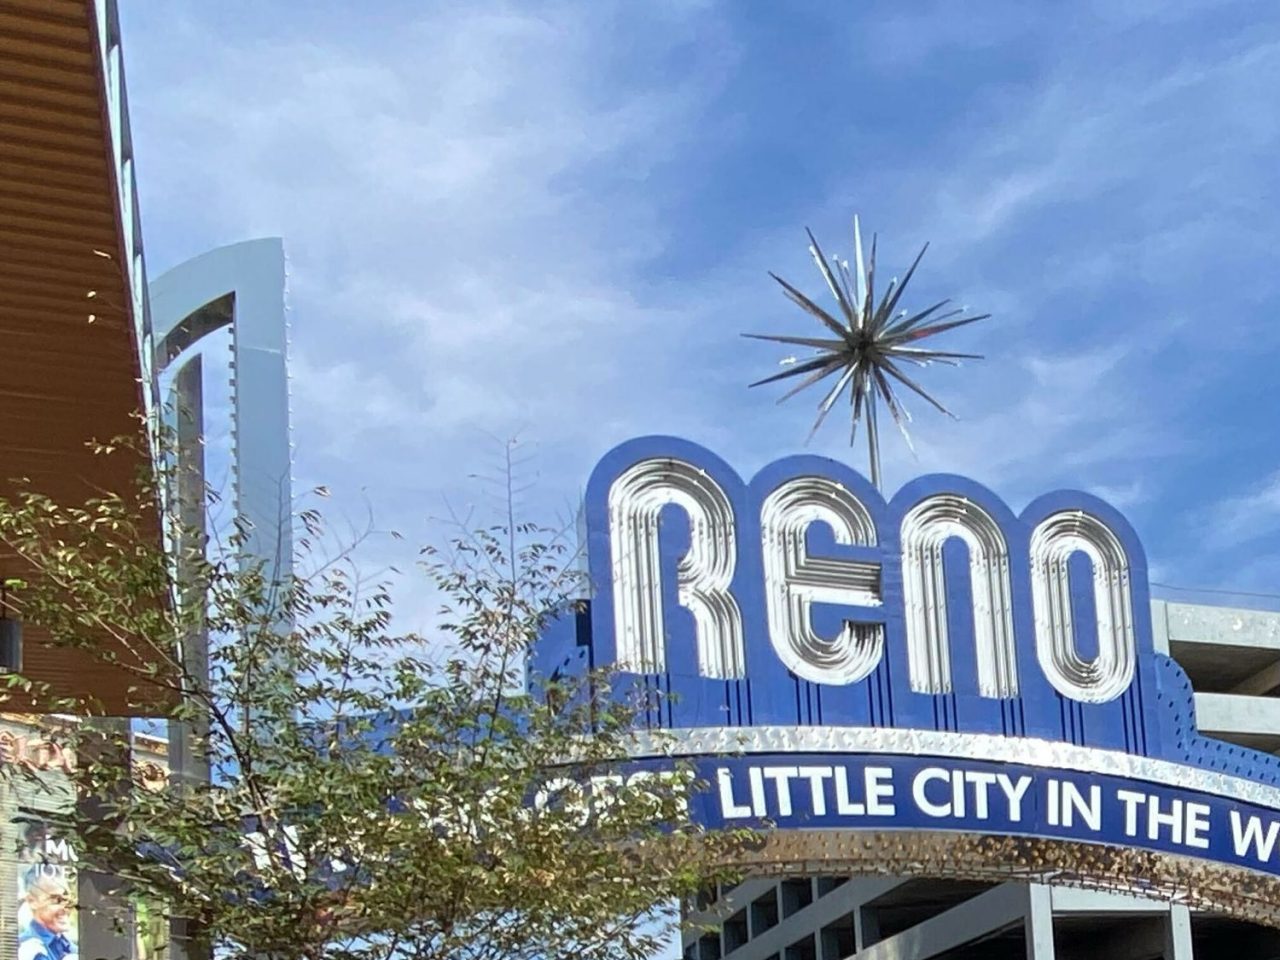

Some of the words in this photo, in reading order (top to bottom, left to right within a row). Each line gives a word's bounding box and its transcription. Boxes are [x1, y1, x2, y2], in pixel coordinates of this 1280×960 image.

[717, 765, 897, 819] LITTLE
[912, 766, 1032, 822] CITY
[1047, 779, 1101, 831] IN
[1117, 789, 1210, 849] THE
